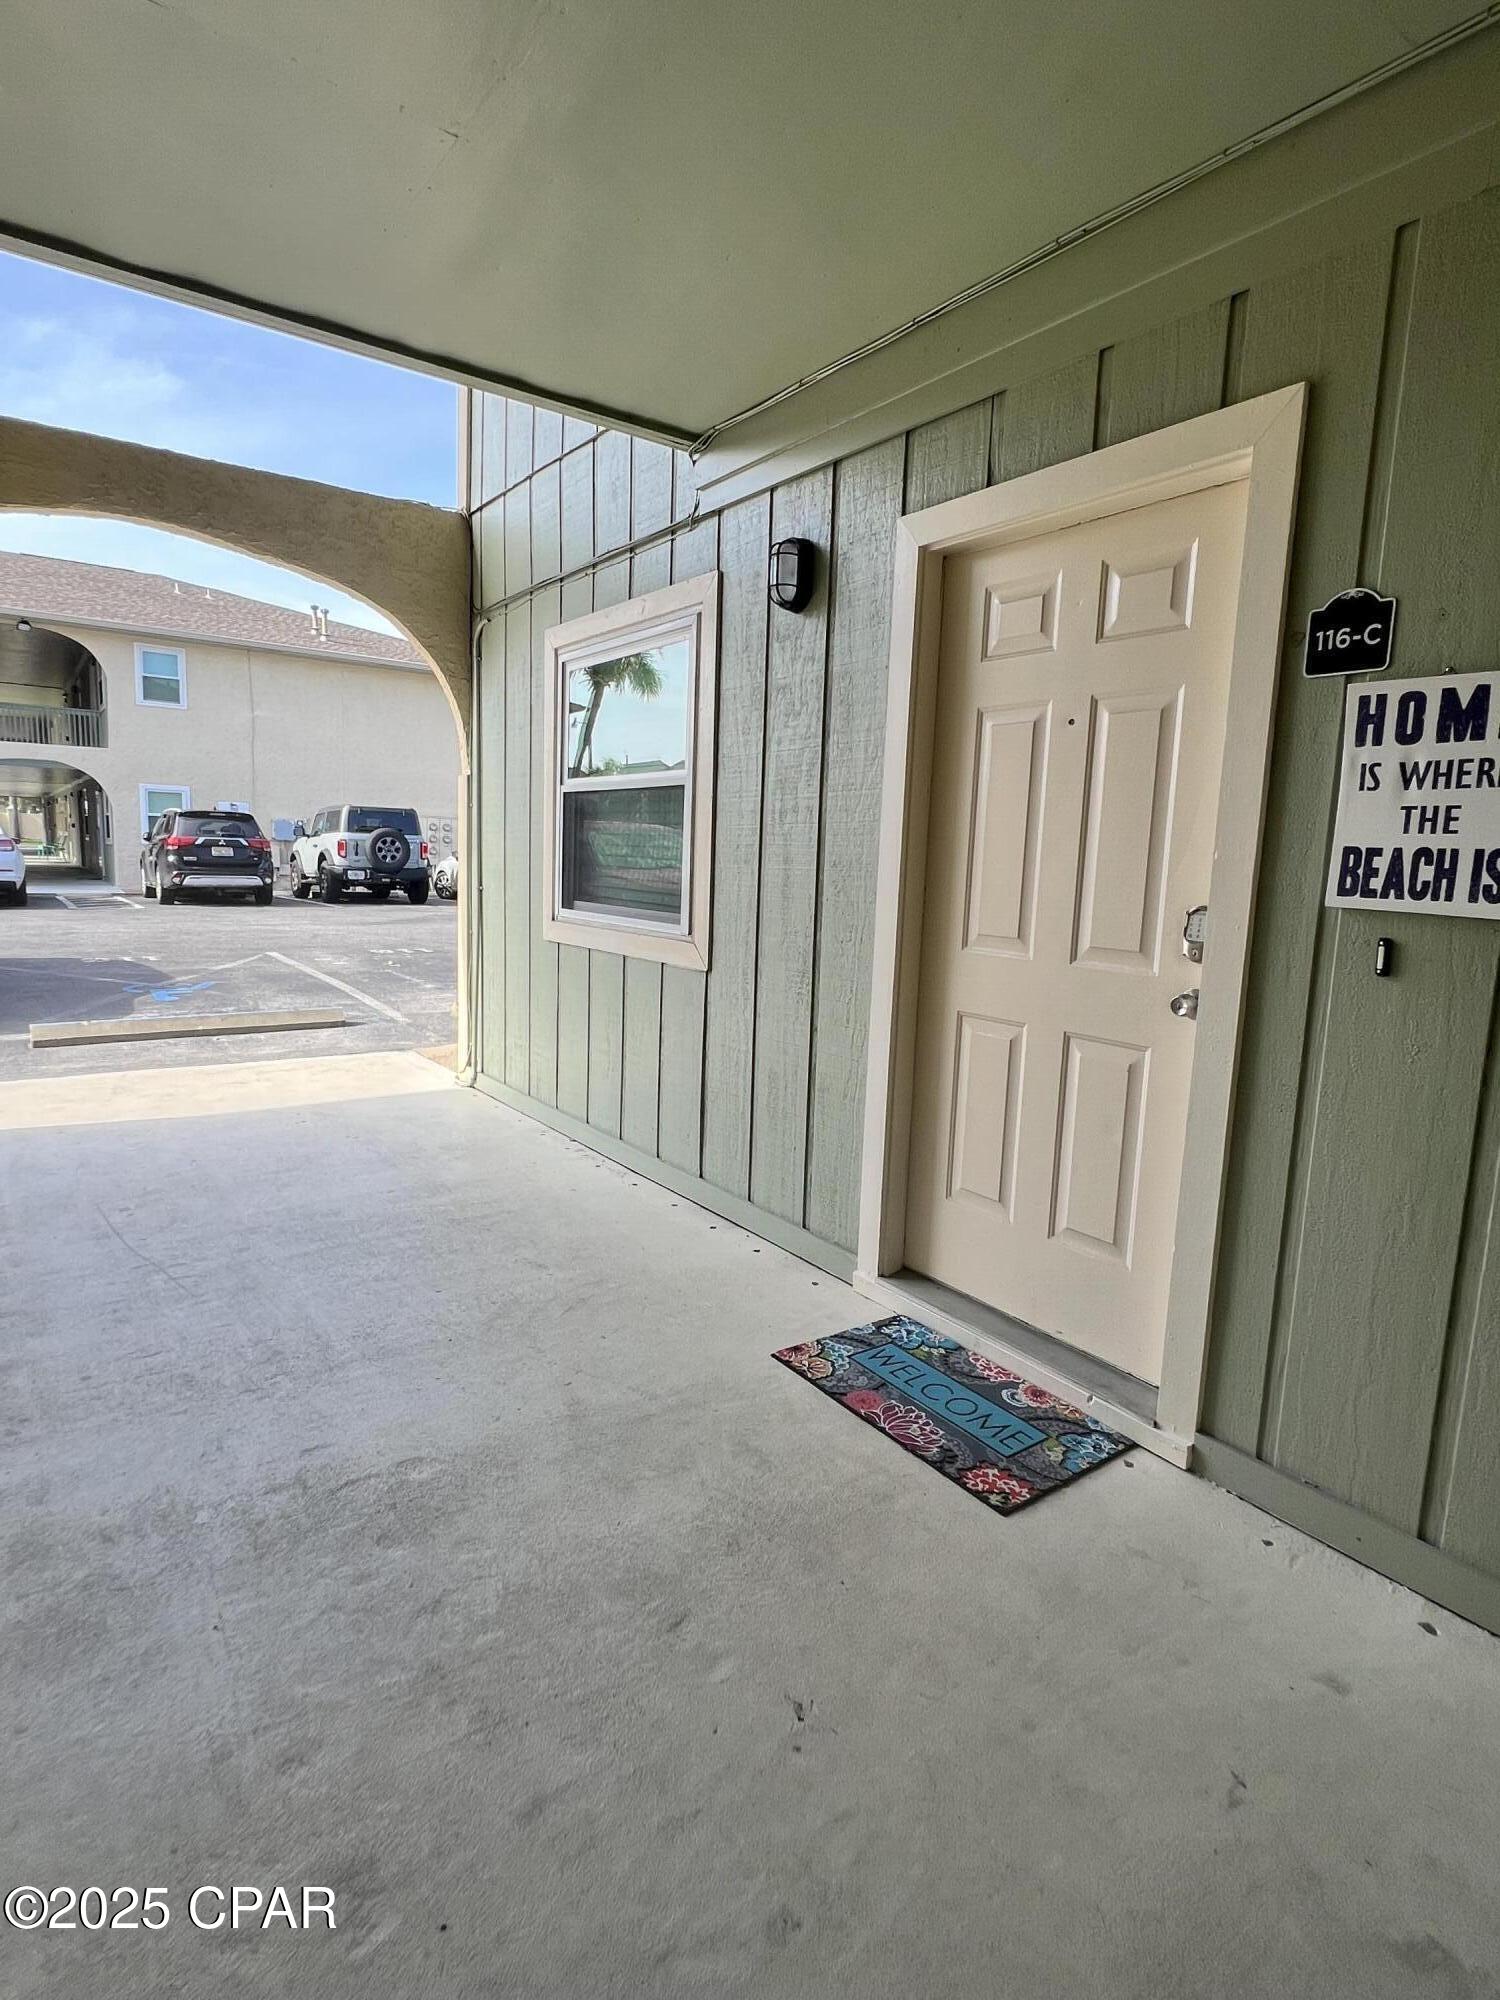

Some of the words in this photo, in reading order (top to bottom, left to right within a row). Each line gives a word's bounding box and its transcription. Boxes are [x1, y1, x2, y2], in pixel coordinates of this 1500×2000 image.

[1315, 623, 1383, 652] 116-C
[1354, 684, 1500, 748] HOM
[1358, 762, 1382, 792] IS
[1399, 757, 1500, 792] WHER
[1400, 805, 1462, 835] THE
[1336, 846, 1460, 902] BEACH
[868, 1349, 1033, 1450] WELCOME
